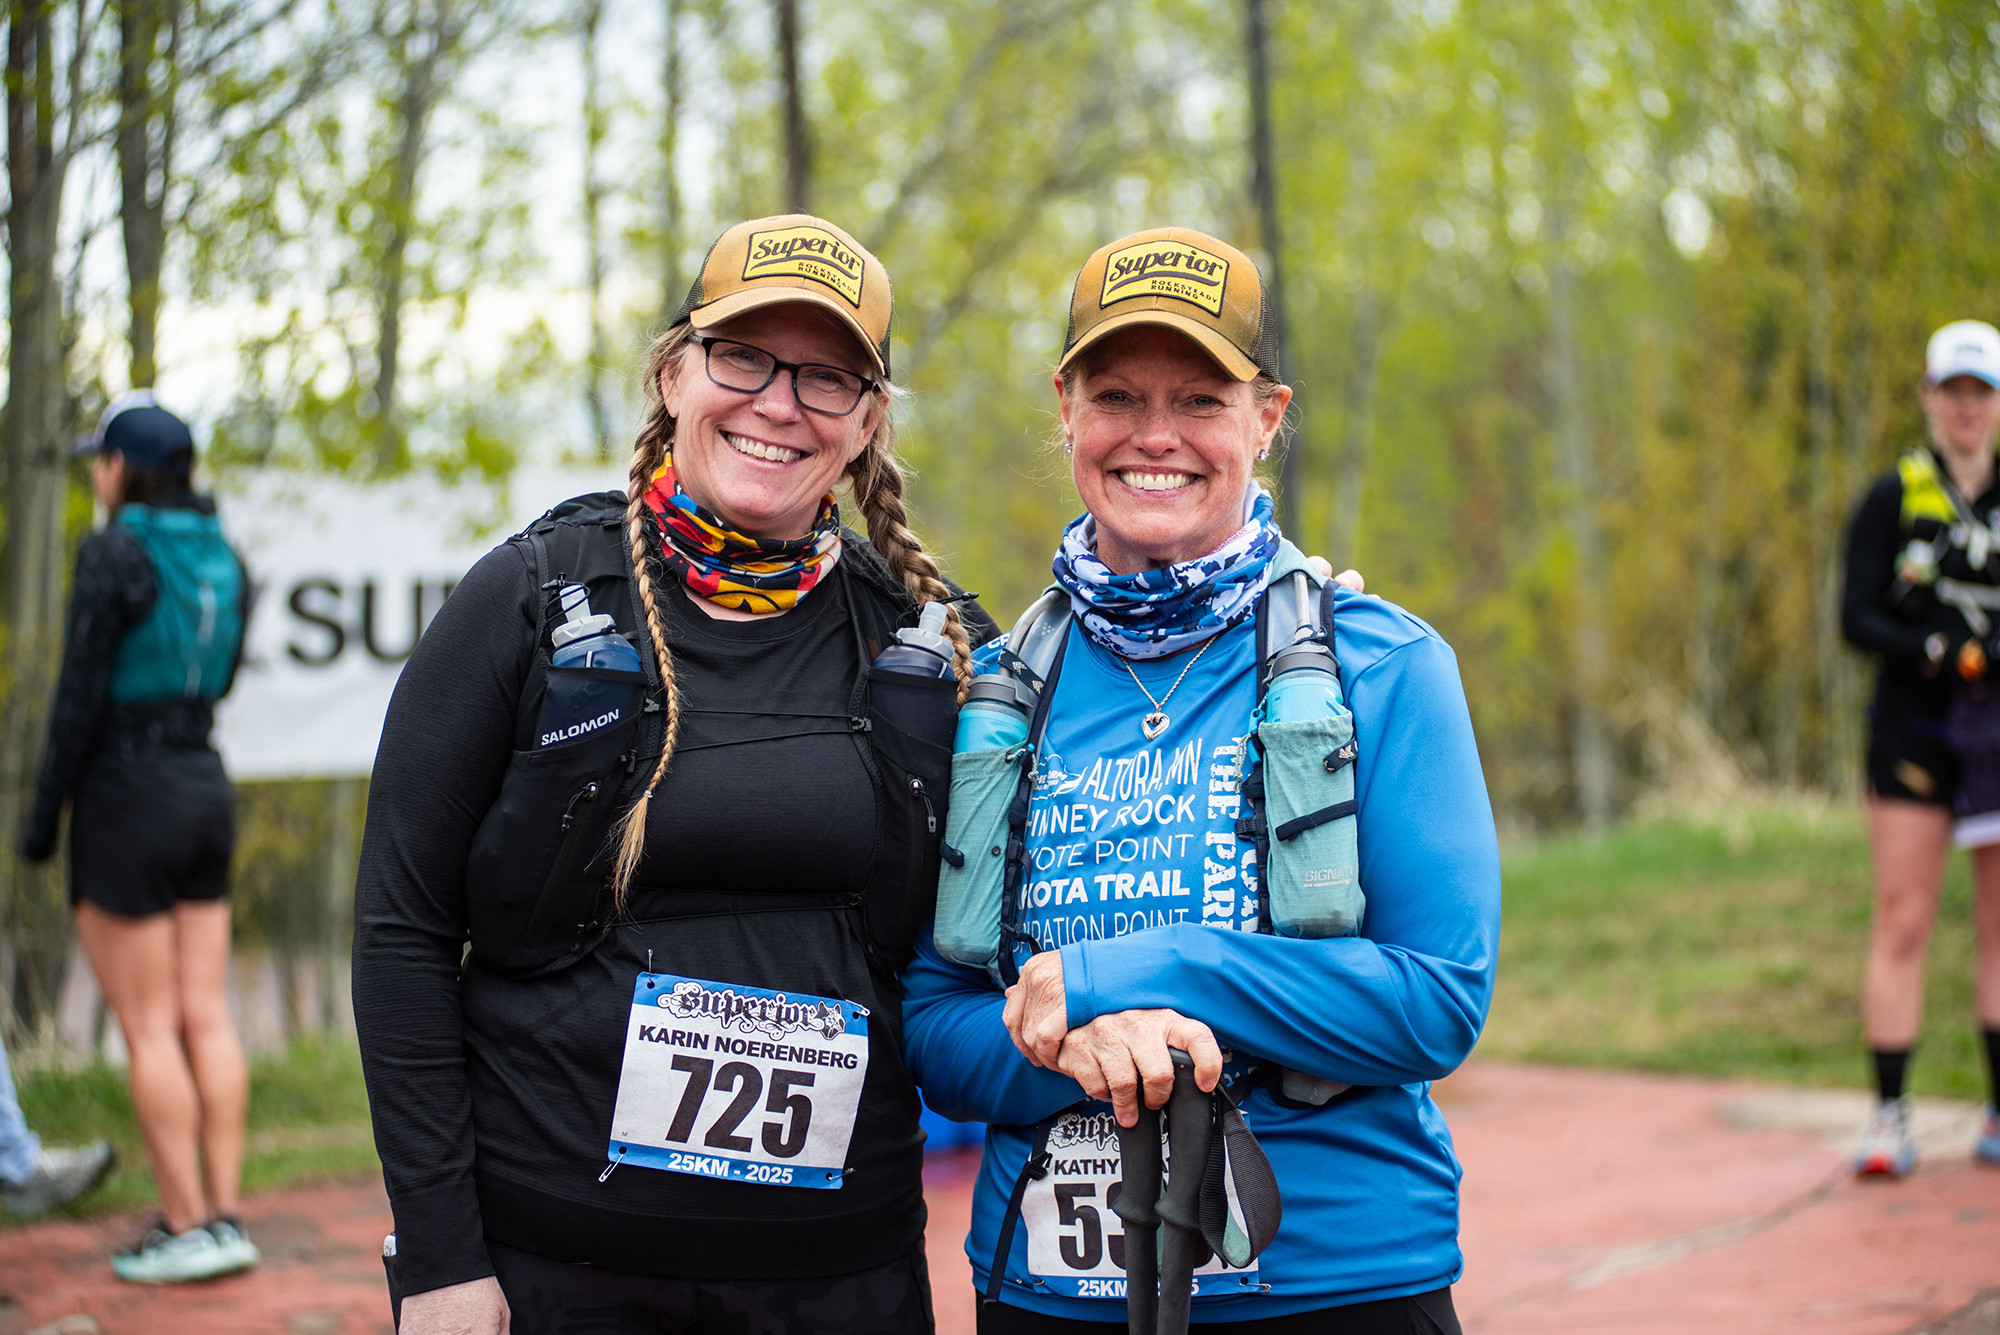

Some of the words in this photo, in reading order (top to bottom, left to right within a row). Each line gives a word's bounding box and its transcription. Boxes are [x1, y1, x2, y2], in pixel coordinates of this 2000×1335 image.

[753, 237, 861, 270] Superior
[1109, 250, 1223, 282] Superior
[798, 267, 841, 288] RUNNING
[798, 262, 856, 295] ROCKSTEADY
[1150, 285, 1198, 299] RUNNING
[1151, 280, 1217, 303] ROCKSTEADY
[286, 577, 460, 667] SU
[541, 708, 620, 746] SALOMON
[1165, 738, 1202, 785] MN
[1208, 737, 1245, 819] THE
[1111, 794, 1196, 828] ROCK
[1096, 834, 1194, 864] POINT
[1018, 877, 1088, 910] KOTA
[1094, 870, 1190, 901] TRAIL
[658, 983, 827, 1041] Superior
[638, 1024, 709, 1050] KARIN
[714, 1035, 858, 1070] NOERENBERG
[665, 1054, 816, 1159] 725
[668, 1152, 729, 1177] 25KM
[746, 1164, 793, 1184] 2025
[1054, 1158, 1120, 1175] KATHY
